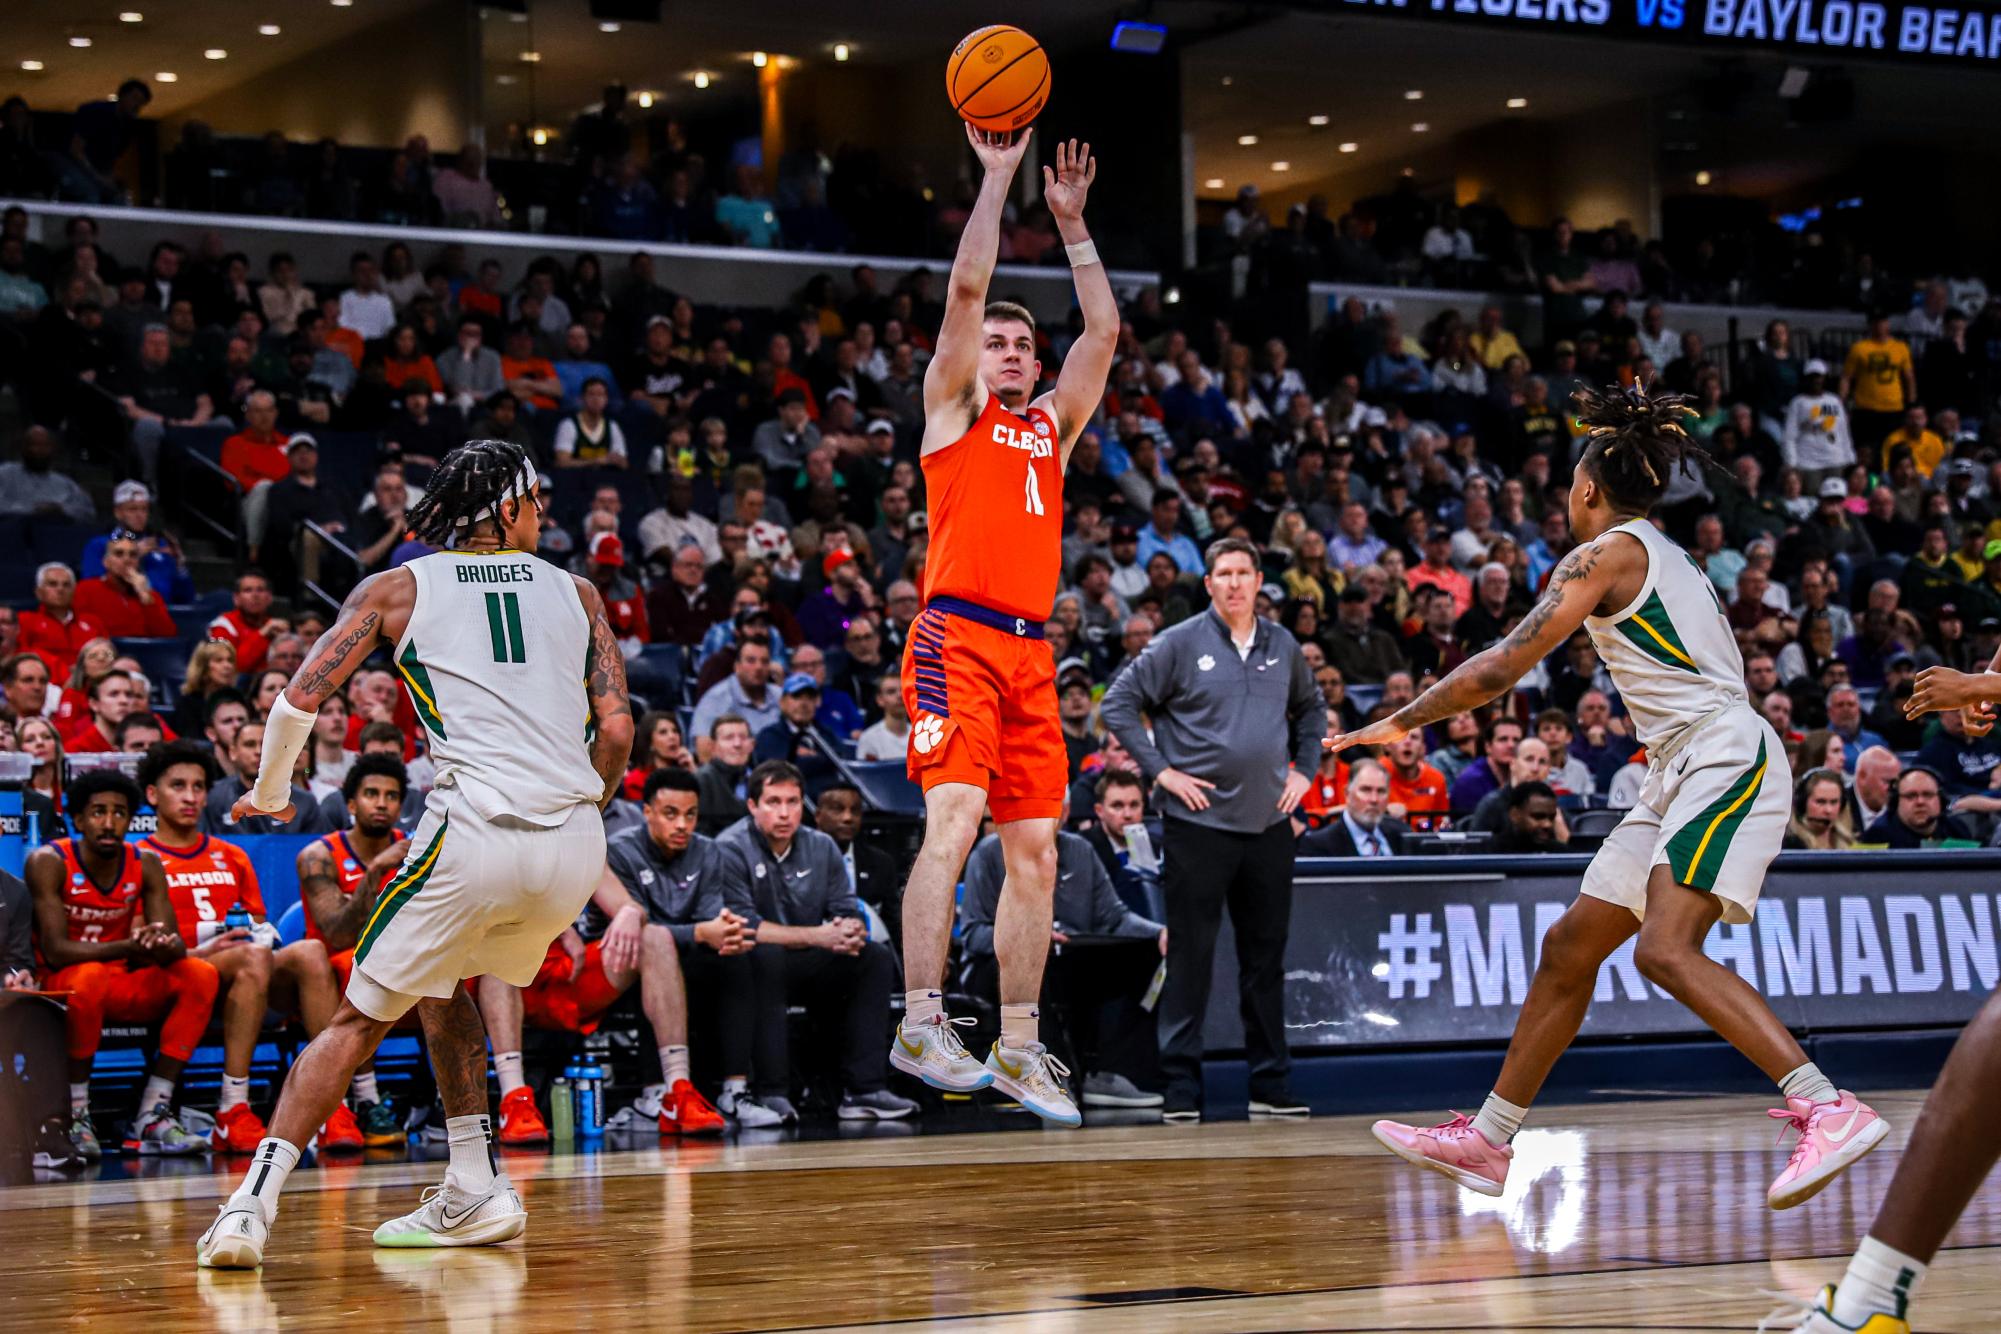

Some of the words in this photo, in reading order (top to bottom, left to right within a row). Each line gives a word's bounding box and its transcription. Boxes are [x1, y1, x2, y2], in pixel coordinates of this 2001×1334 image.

[1431, 0, 1611, 25] GERS
[1636, 0, 1685, 28] VS
[1703, 0, 1887, 49] BAYLOR
[455, 564, 534, 583] BRIDGES
[484, 592, 526, 663] 11
[165, 871, 236, 888] LEMSON
[192, 888, 216, 920] 5
